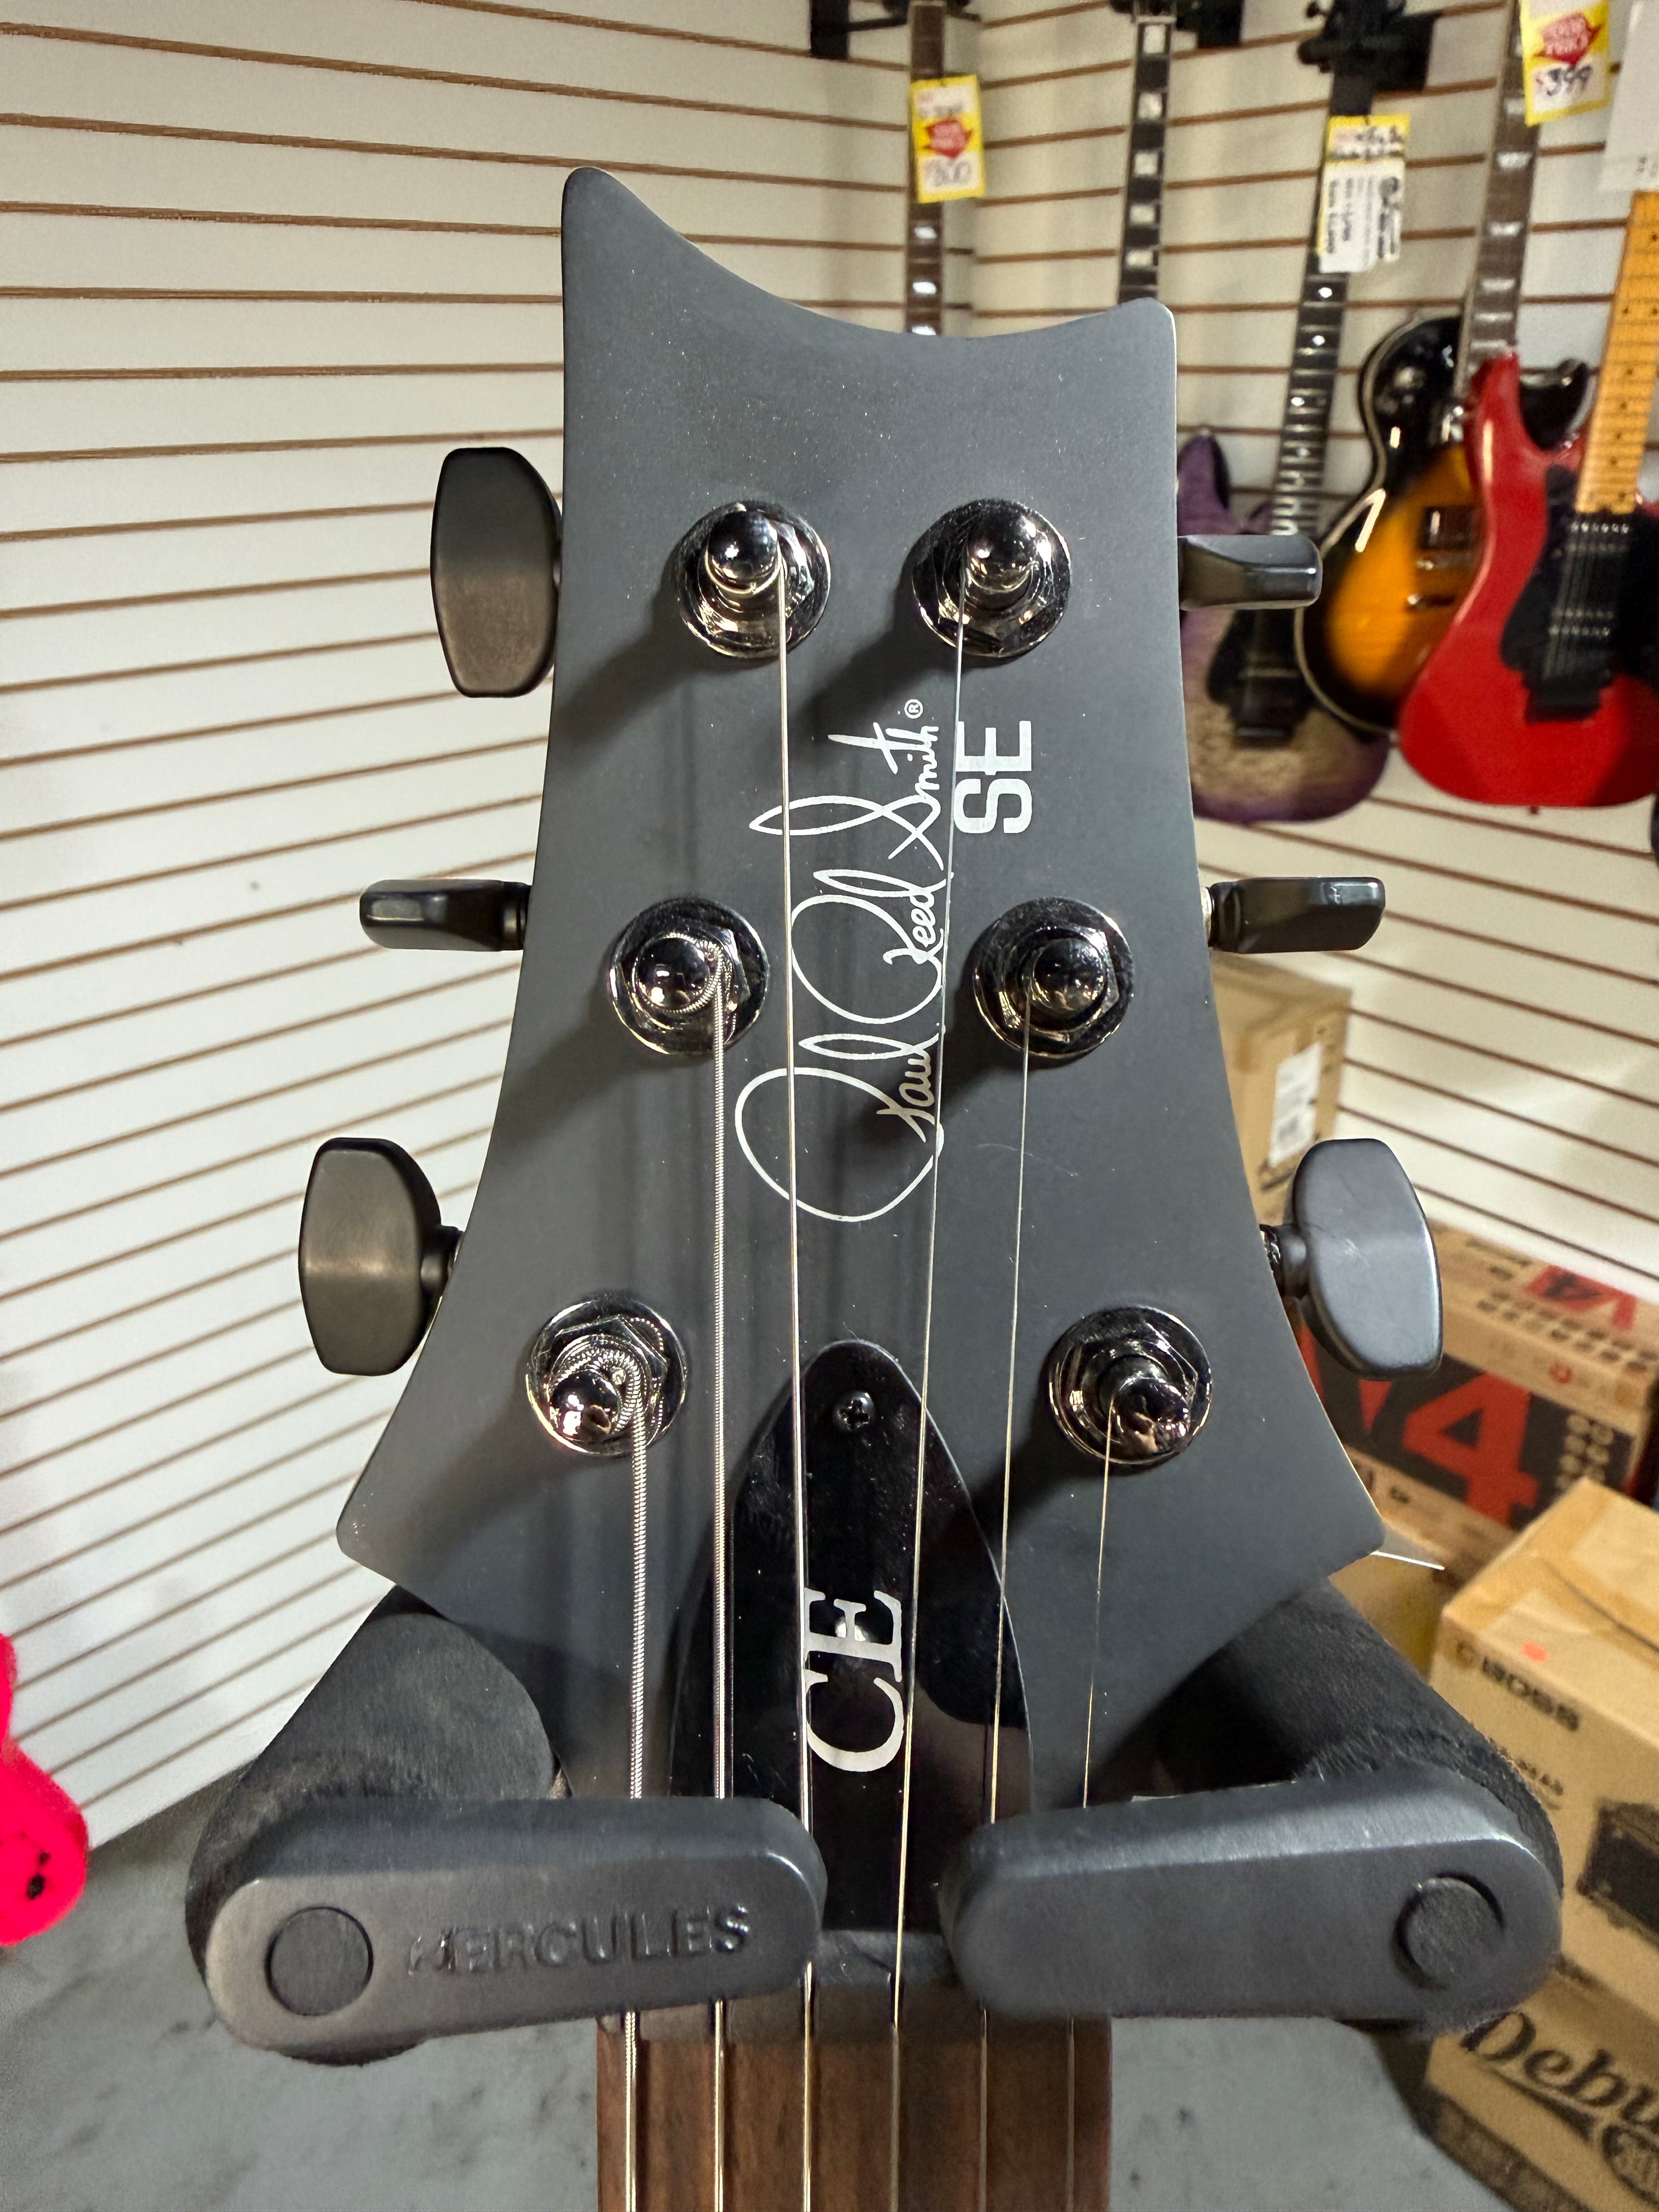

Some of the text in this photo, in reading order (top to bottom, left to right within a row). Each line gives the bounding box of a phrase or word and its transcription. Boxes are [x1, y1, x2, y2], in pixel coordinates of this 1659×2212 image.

[953, 720, 1032, 834] SE
[791, 869, 953, 1024] Reed
[735, 1025, 945, 1222] Paul
[804, 1588, 904, 1772] CE
[409, 1905, 749, 1976] HERCULES
